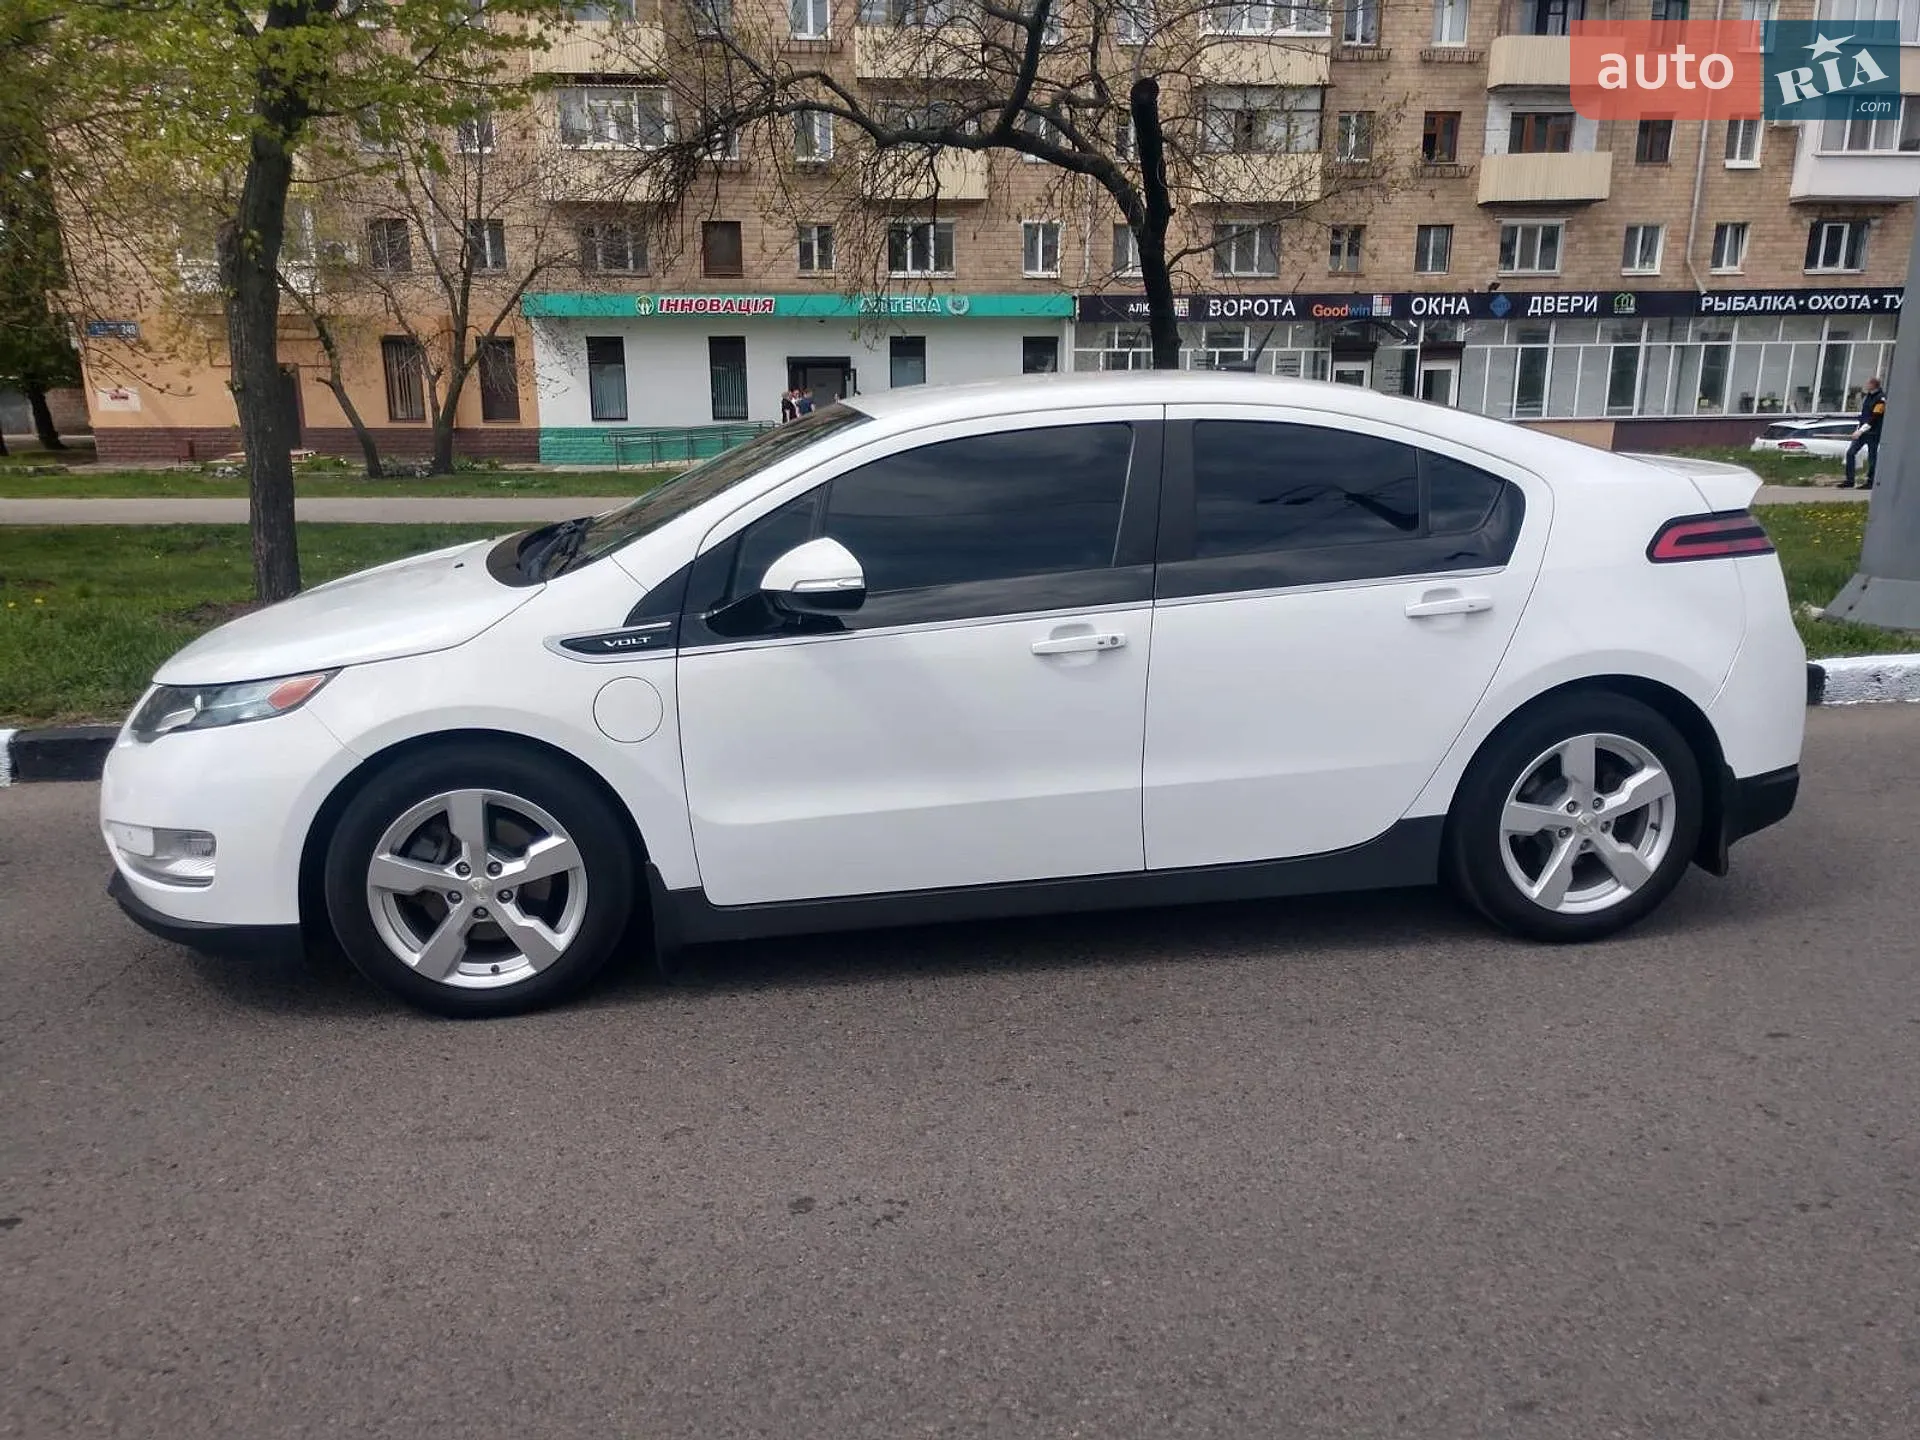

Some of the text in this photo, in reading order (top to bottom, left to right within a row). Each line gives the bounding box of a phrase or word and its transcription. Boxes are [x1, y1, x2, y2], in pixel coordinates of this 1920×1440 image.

[657, 297, 776, 316] ІННОВАЦІЯ
[1208, 298, 1297, 317] ВОРОТА
[1312, 303, 1371, 317] Goodwin
[1410, 297, 1471, 316] ОКНА
[1527, 295, 1599, 316] ДВЕРИ
[1700, 294, 1904, 312] РЫБАЛКА ОХОТА ТУ
[603, 637, 651, 647] VOLT
